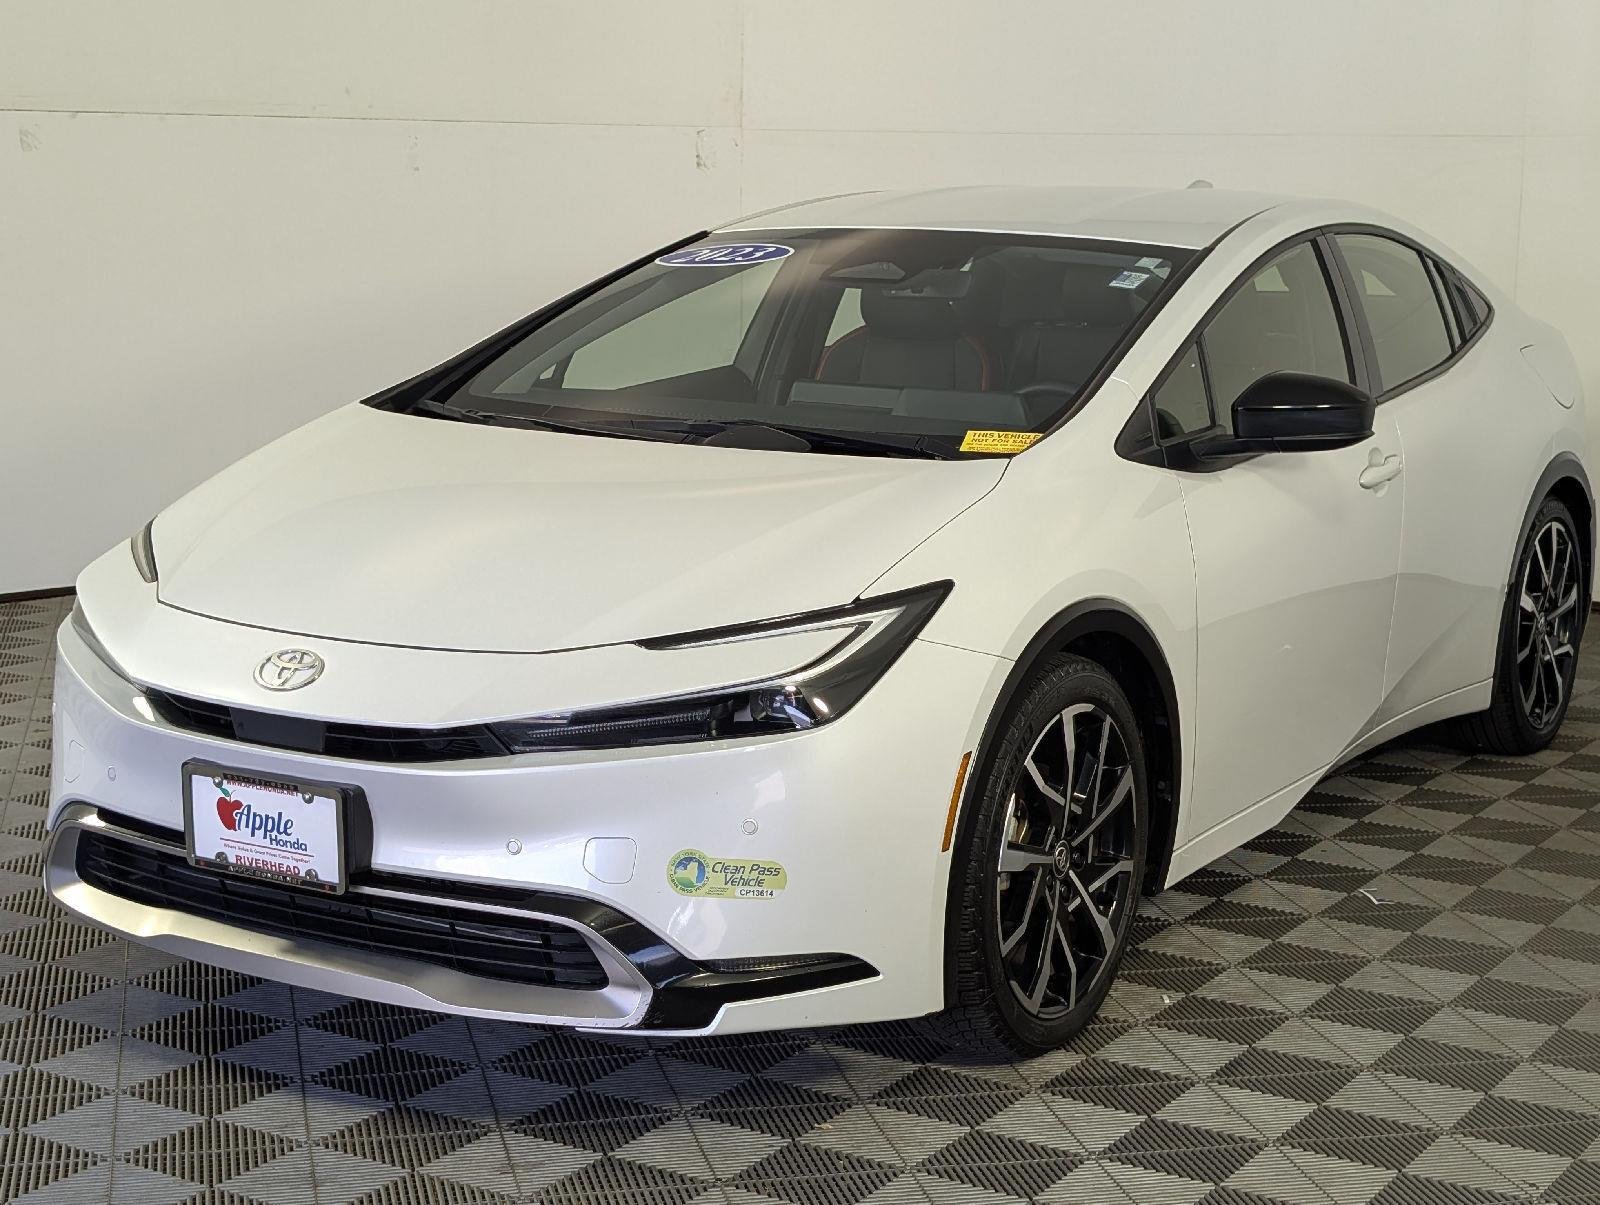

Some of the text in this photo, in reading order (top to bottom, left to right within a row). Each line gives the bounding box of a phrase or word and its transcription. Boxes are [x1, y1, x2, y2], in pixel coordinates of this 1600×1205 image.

[669, 246, 776, 262] 2023
[235, 804, 294, 839] Apple
[269, 834, 308, 852] Honda
[235, 855, 301, 875] RIVERHEAD
[711, 861, 781, 877] Clean Pass
[724, 874, 765, 887] Vehicle
[739, 888, 774, 898] CP13614
